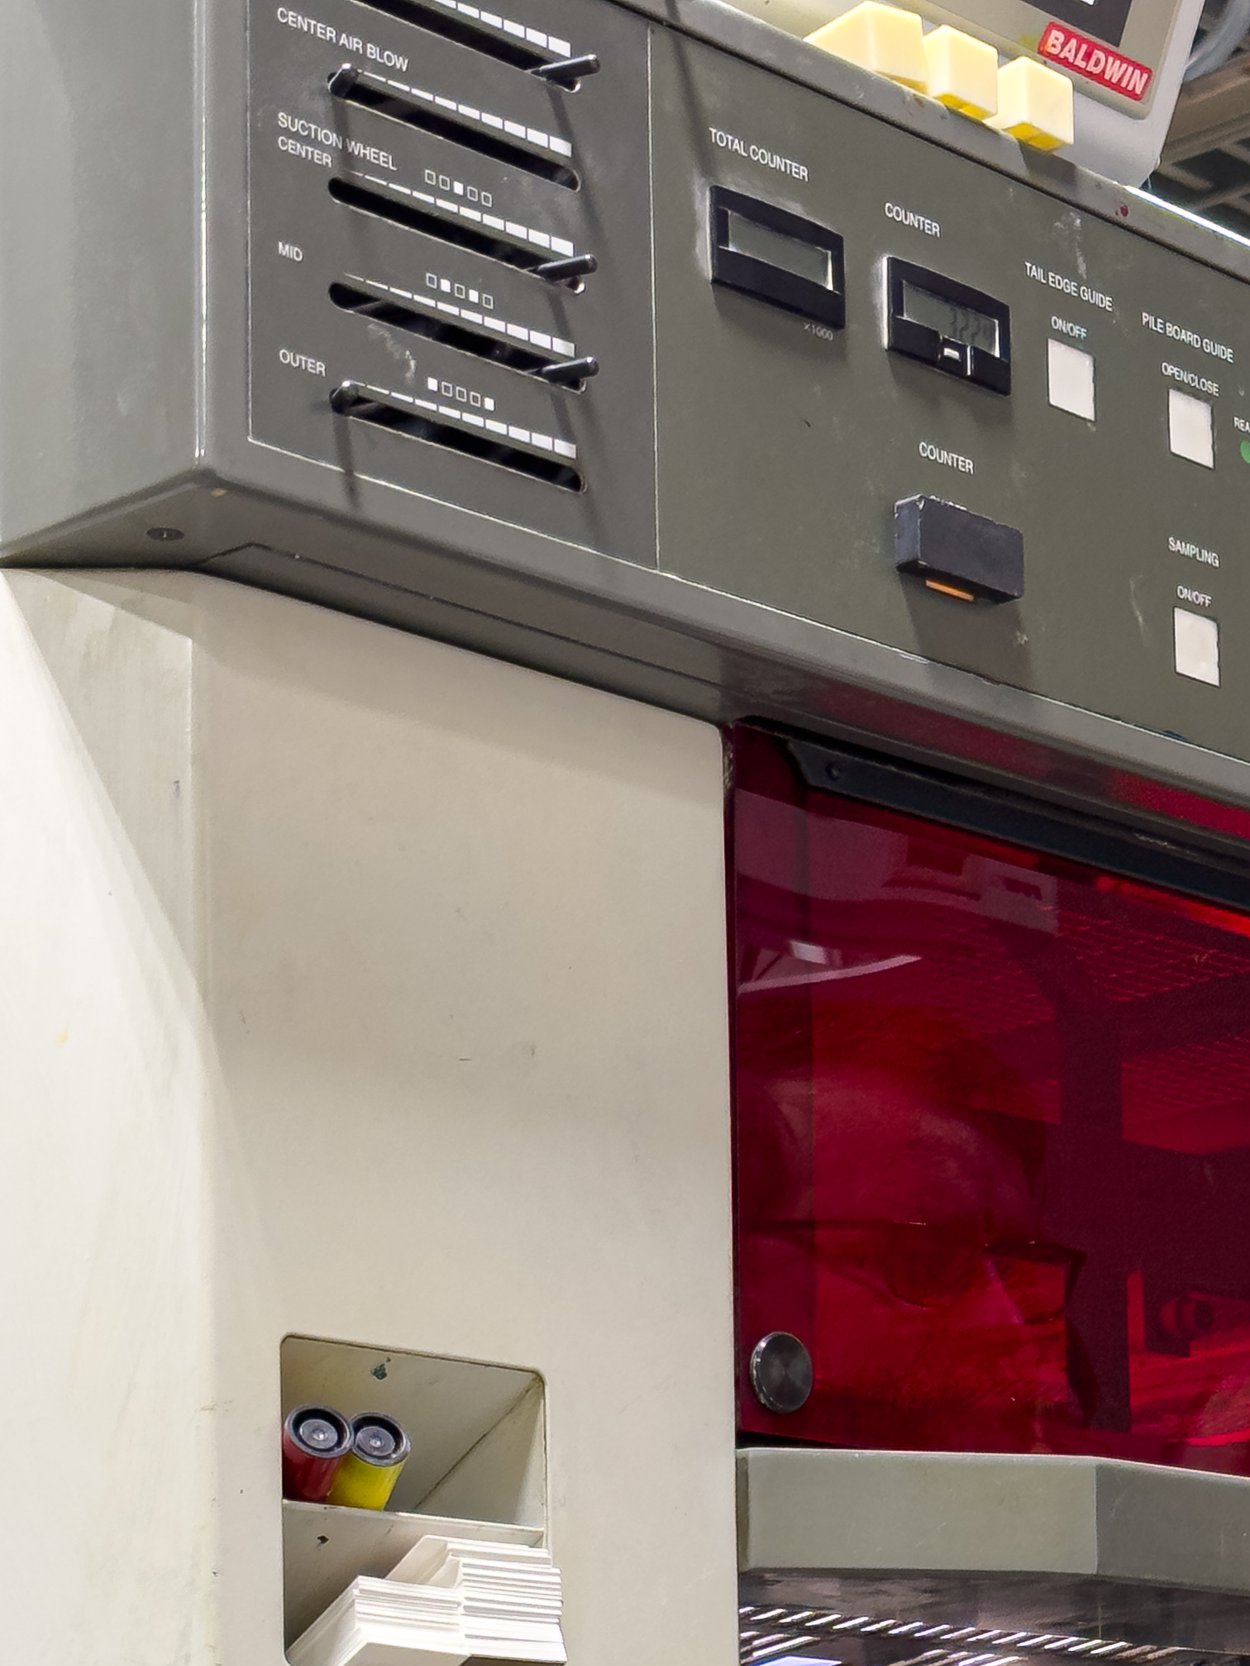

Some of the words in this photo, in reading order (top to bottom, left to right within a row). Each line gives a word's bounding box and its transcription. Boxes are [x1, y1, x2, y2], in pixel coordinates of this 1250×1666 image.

[277, 8, 337, 44] CENTER
[340, 33, 363, 54] AIR
[366, 43, 408, 72] BLOW
[1047, 29, 1148, 95] BALDWIN
[278, 112, 342, 150] SUCTION
[346, 139, 397, 170] WHEEL
[278, 137, 332, 168] CENTER
[709, 128, 748, 159] TOTAL
[750, 144, 809, 182] COUNTER
[884, 202, 941, 238] COUNTER
[278, 242, 303, 262] MID
[1024, 261, 1047, 287] TAIL
[1048, 270, 1078, 298] EDGE
[1080, 280, 1113, 312] GUIDE
[1051, 316, 1087, 340] ON/OFF
[1142, 312, 1164, 335] PILE
[1165, 320, 1201, 350] BOARD
[1203, 334, 1234, 364] GUIDE
[279, 349, 326, 376] OUTER
[1162, 362, 1219, 397] OPEN/CLOSE
[919, 441, 974, 475] COUNTER
[1168, 537, 1220, 568] SAMPLING
[1176, 585, 1212, 608] ON/OFF
